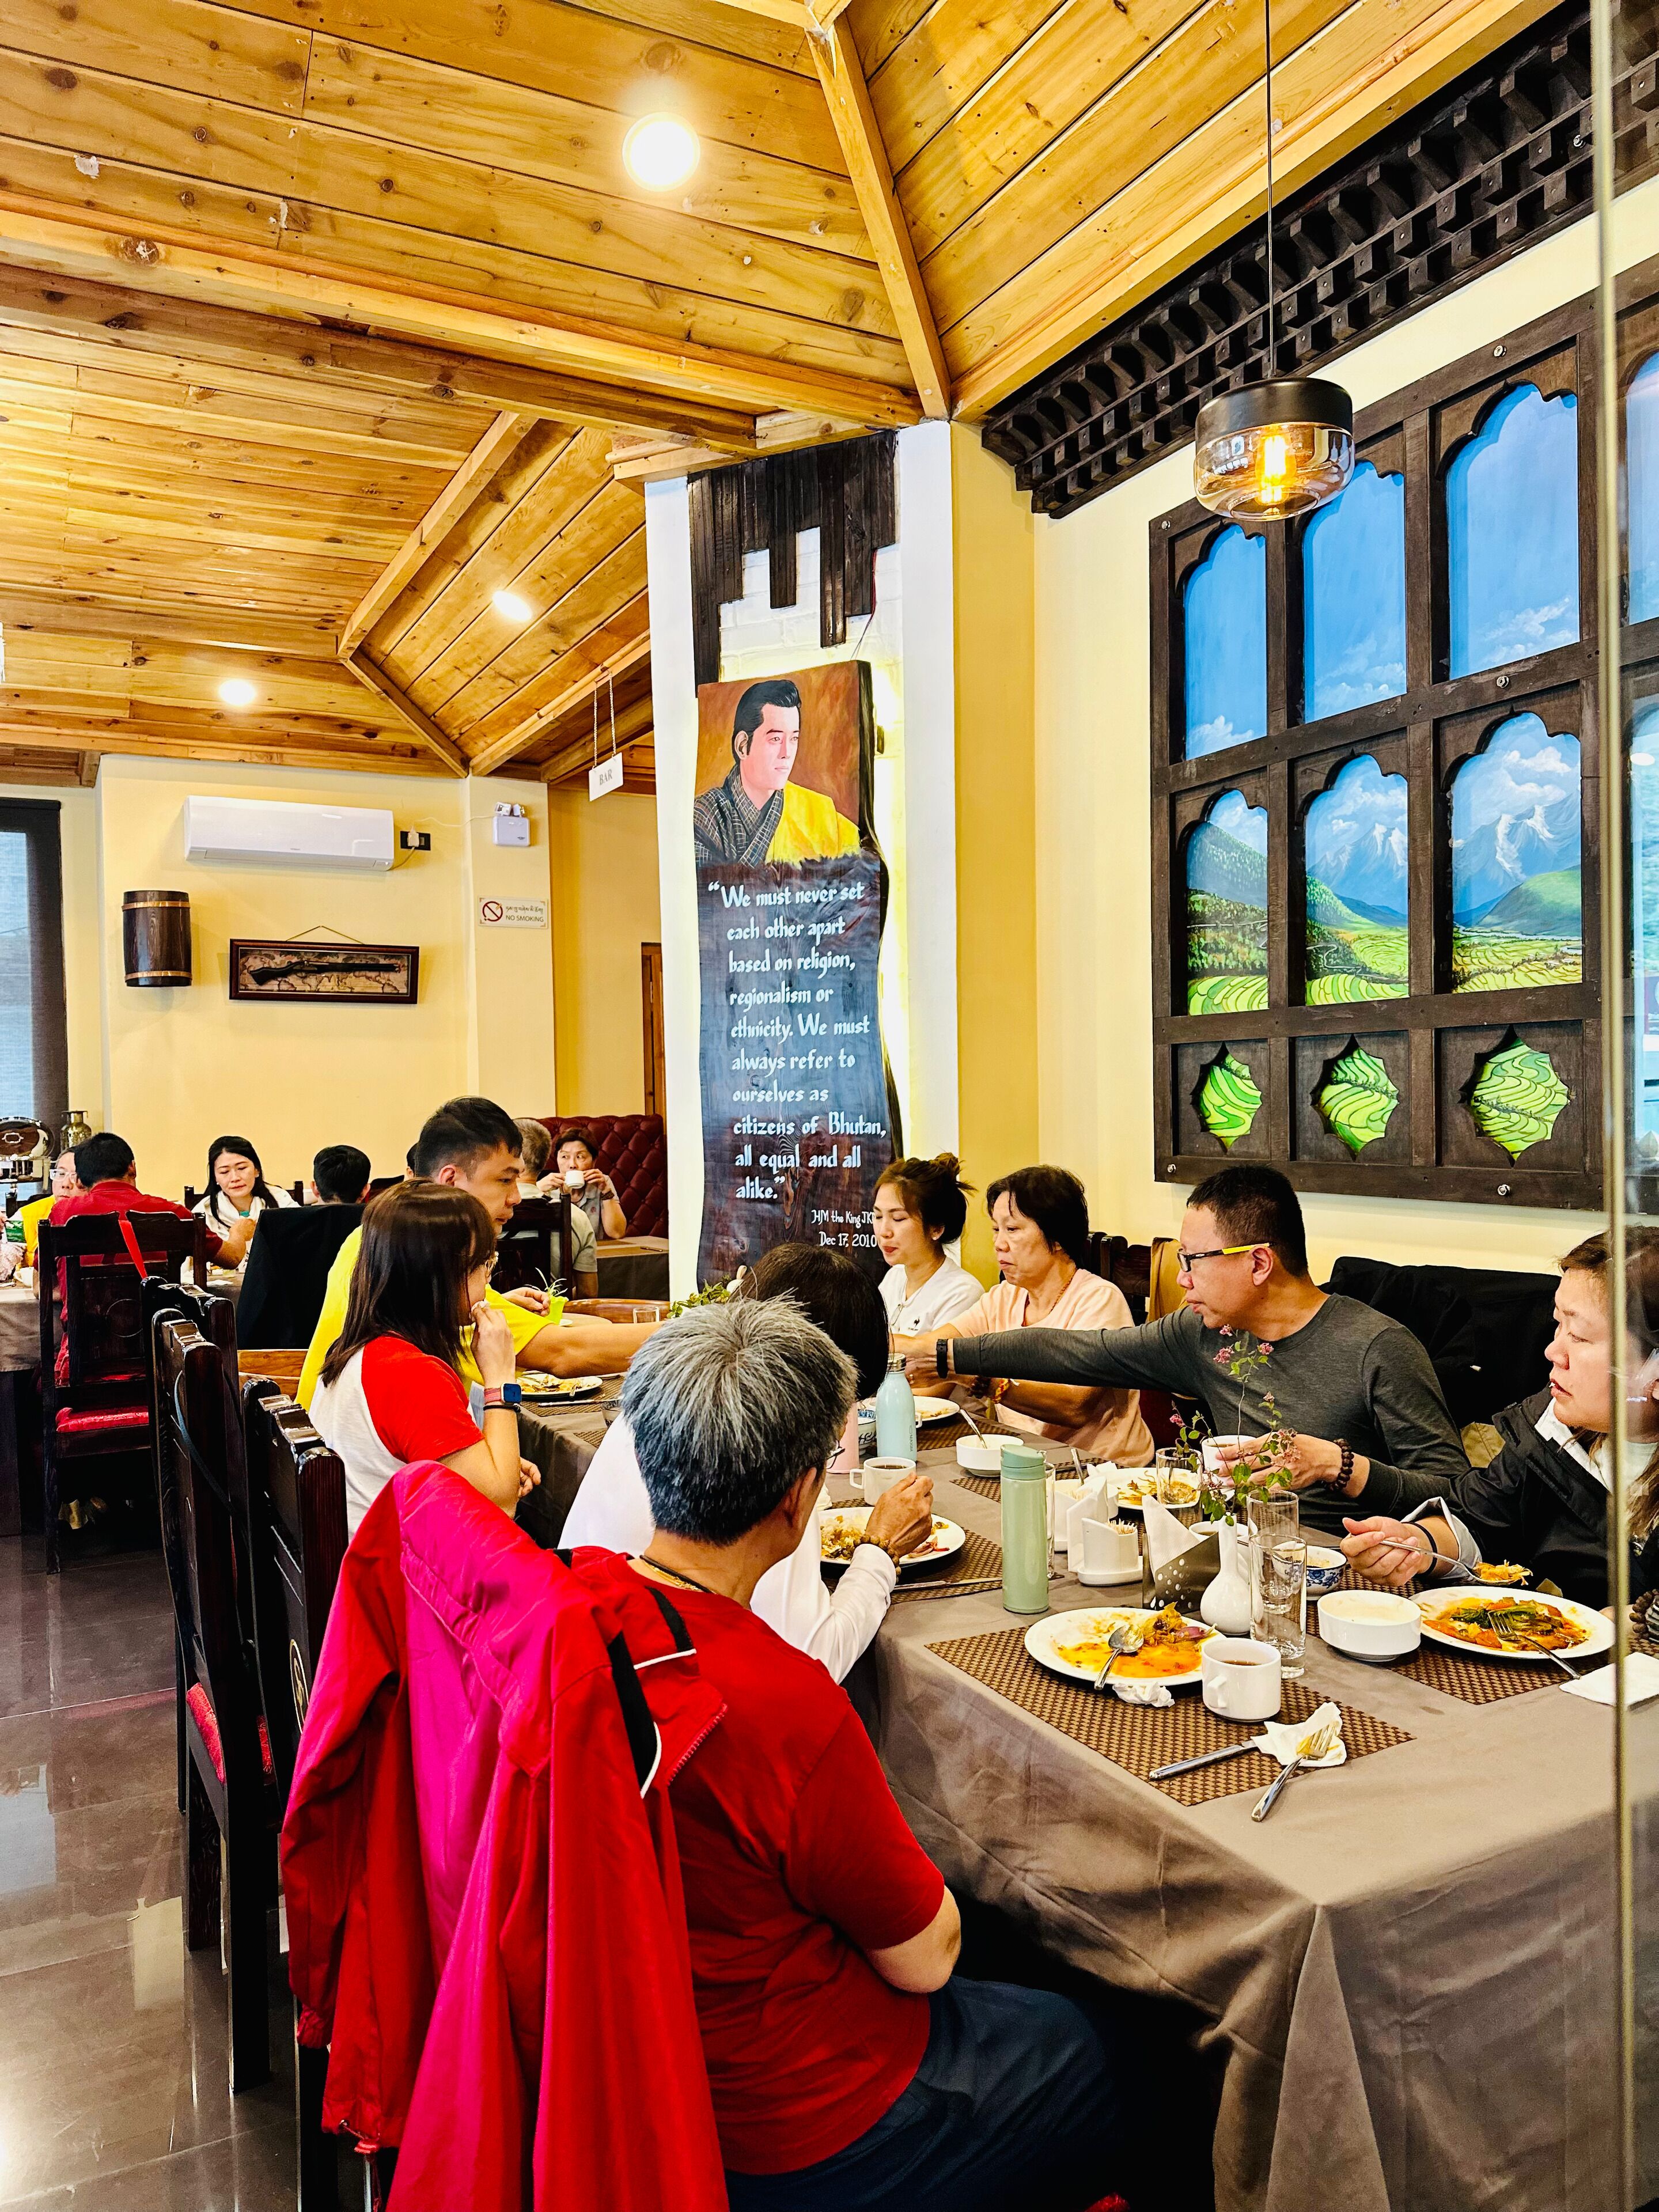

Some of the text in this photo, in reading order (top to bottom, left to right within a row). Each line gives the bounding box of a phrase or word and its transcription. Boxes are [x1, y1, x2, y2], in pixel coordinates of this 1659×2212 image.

[599, 769, 612, 786] BAR
[755, 886, 793, 907] must
[794, 887, 838, 904] never
[839, 881, 865, 901] set
[727, 915, 846, 946] each other apart
[729, 946, 855, 979] based on religion,
[730, 980, 834, 1014] regionalism or
[730, 1012, 870, 1046] ethnicity. We must
[731, 1047, 855, 1079] always refer to
[732, 1080, 829, 1103] ourselves as
[733, 1111, 887, 1138] citizens of Bhutan,
[735, 1143, 861, 1175] all equal and all
[811, 1209, 829, 1225] HM
[831, 1210, 844, 1223] the
[846, 1211, 862, 1229] King
[819, 1231, 877, 1248] Dec 17, 2010
